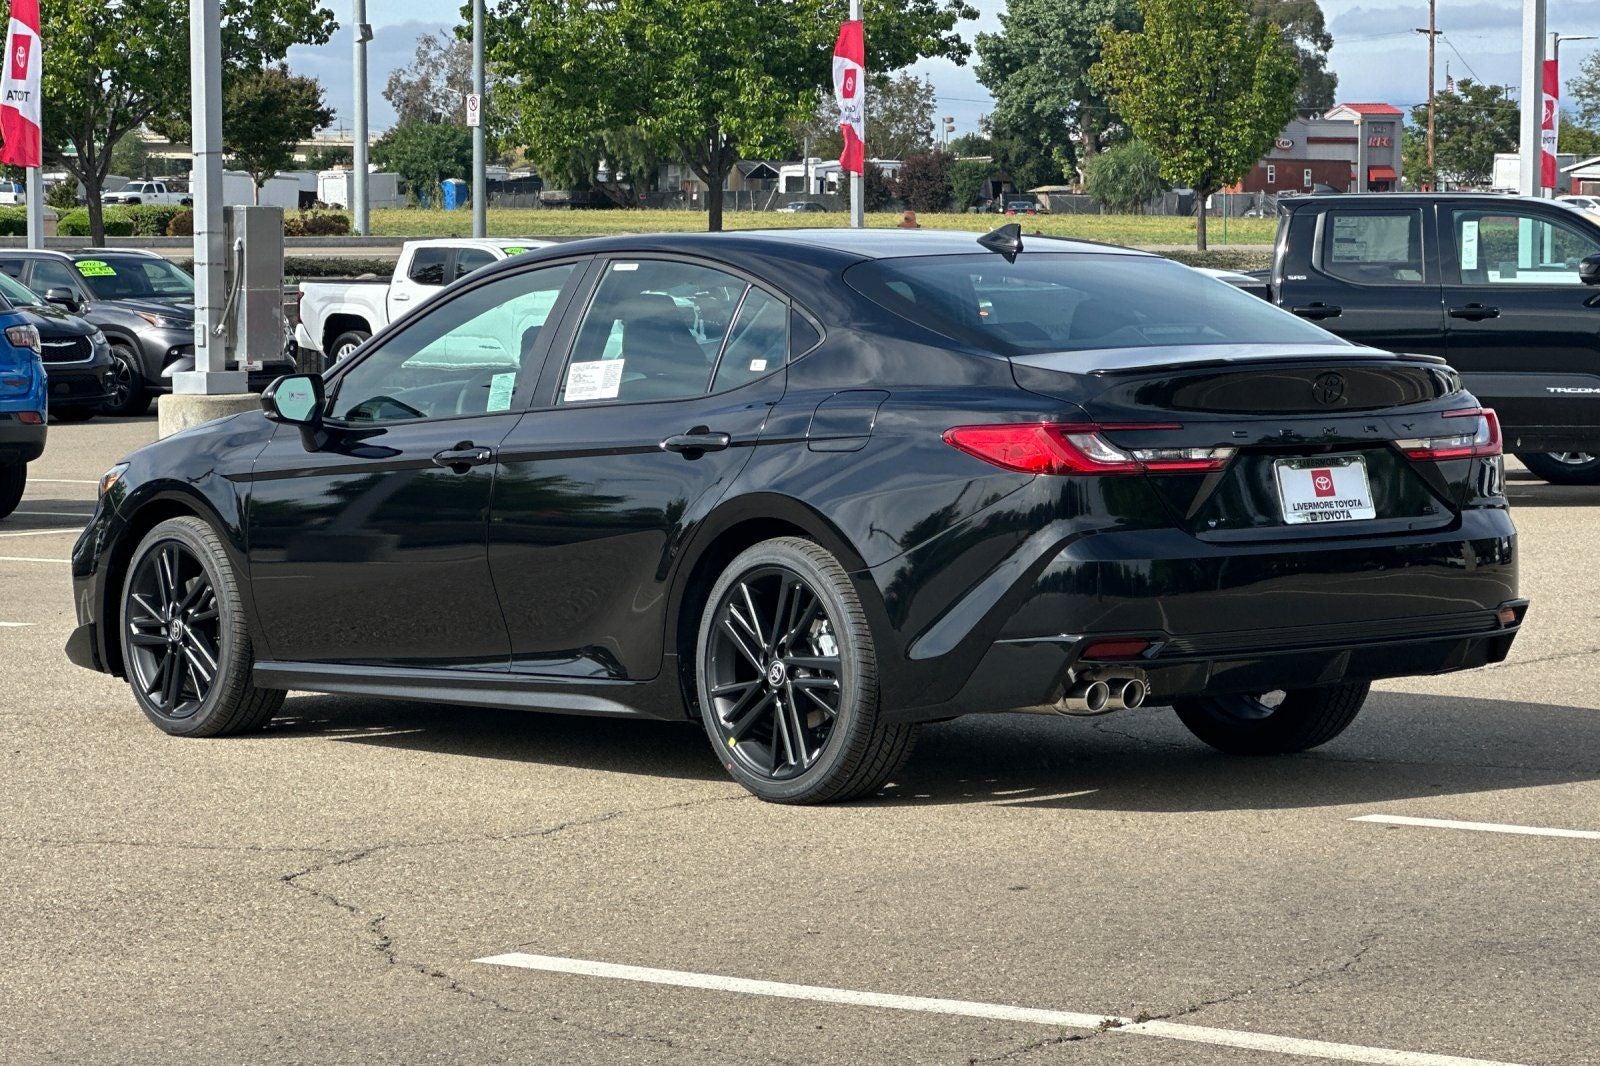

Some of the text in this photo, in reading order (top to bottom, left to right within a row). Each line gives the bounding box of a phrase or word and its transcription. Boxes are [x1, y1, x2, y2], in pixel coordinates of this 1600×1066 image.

[1292, 499, 1363, 511] LIVERMORE TOYOTA
[1319, 510, 1352, 520] TOYOTA
